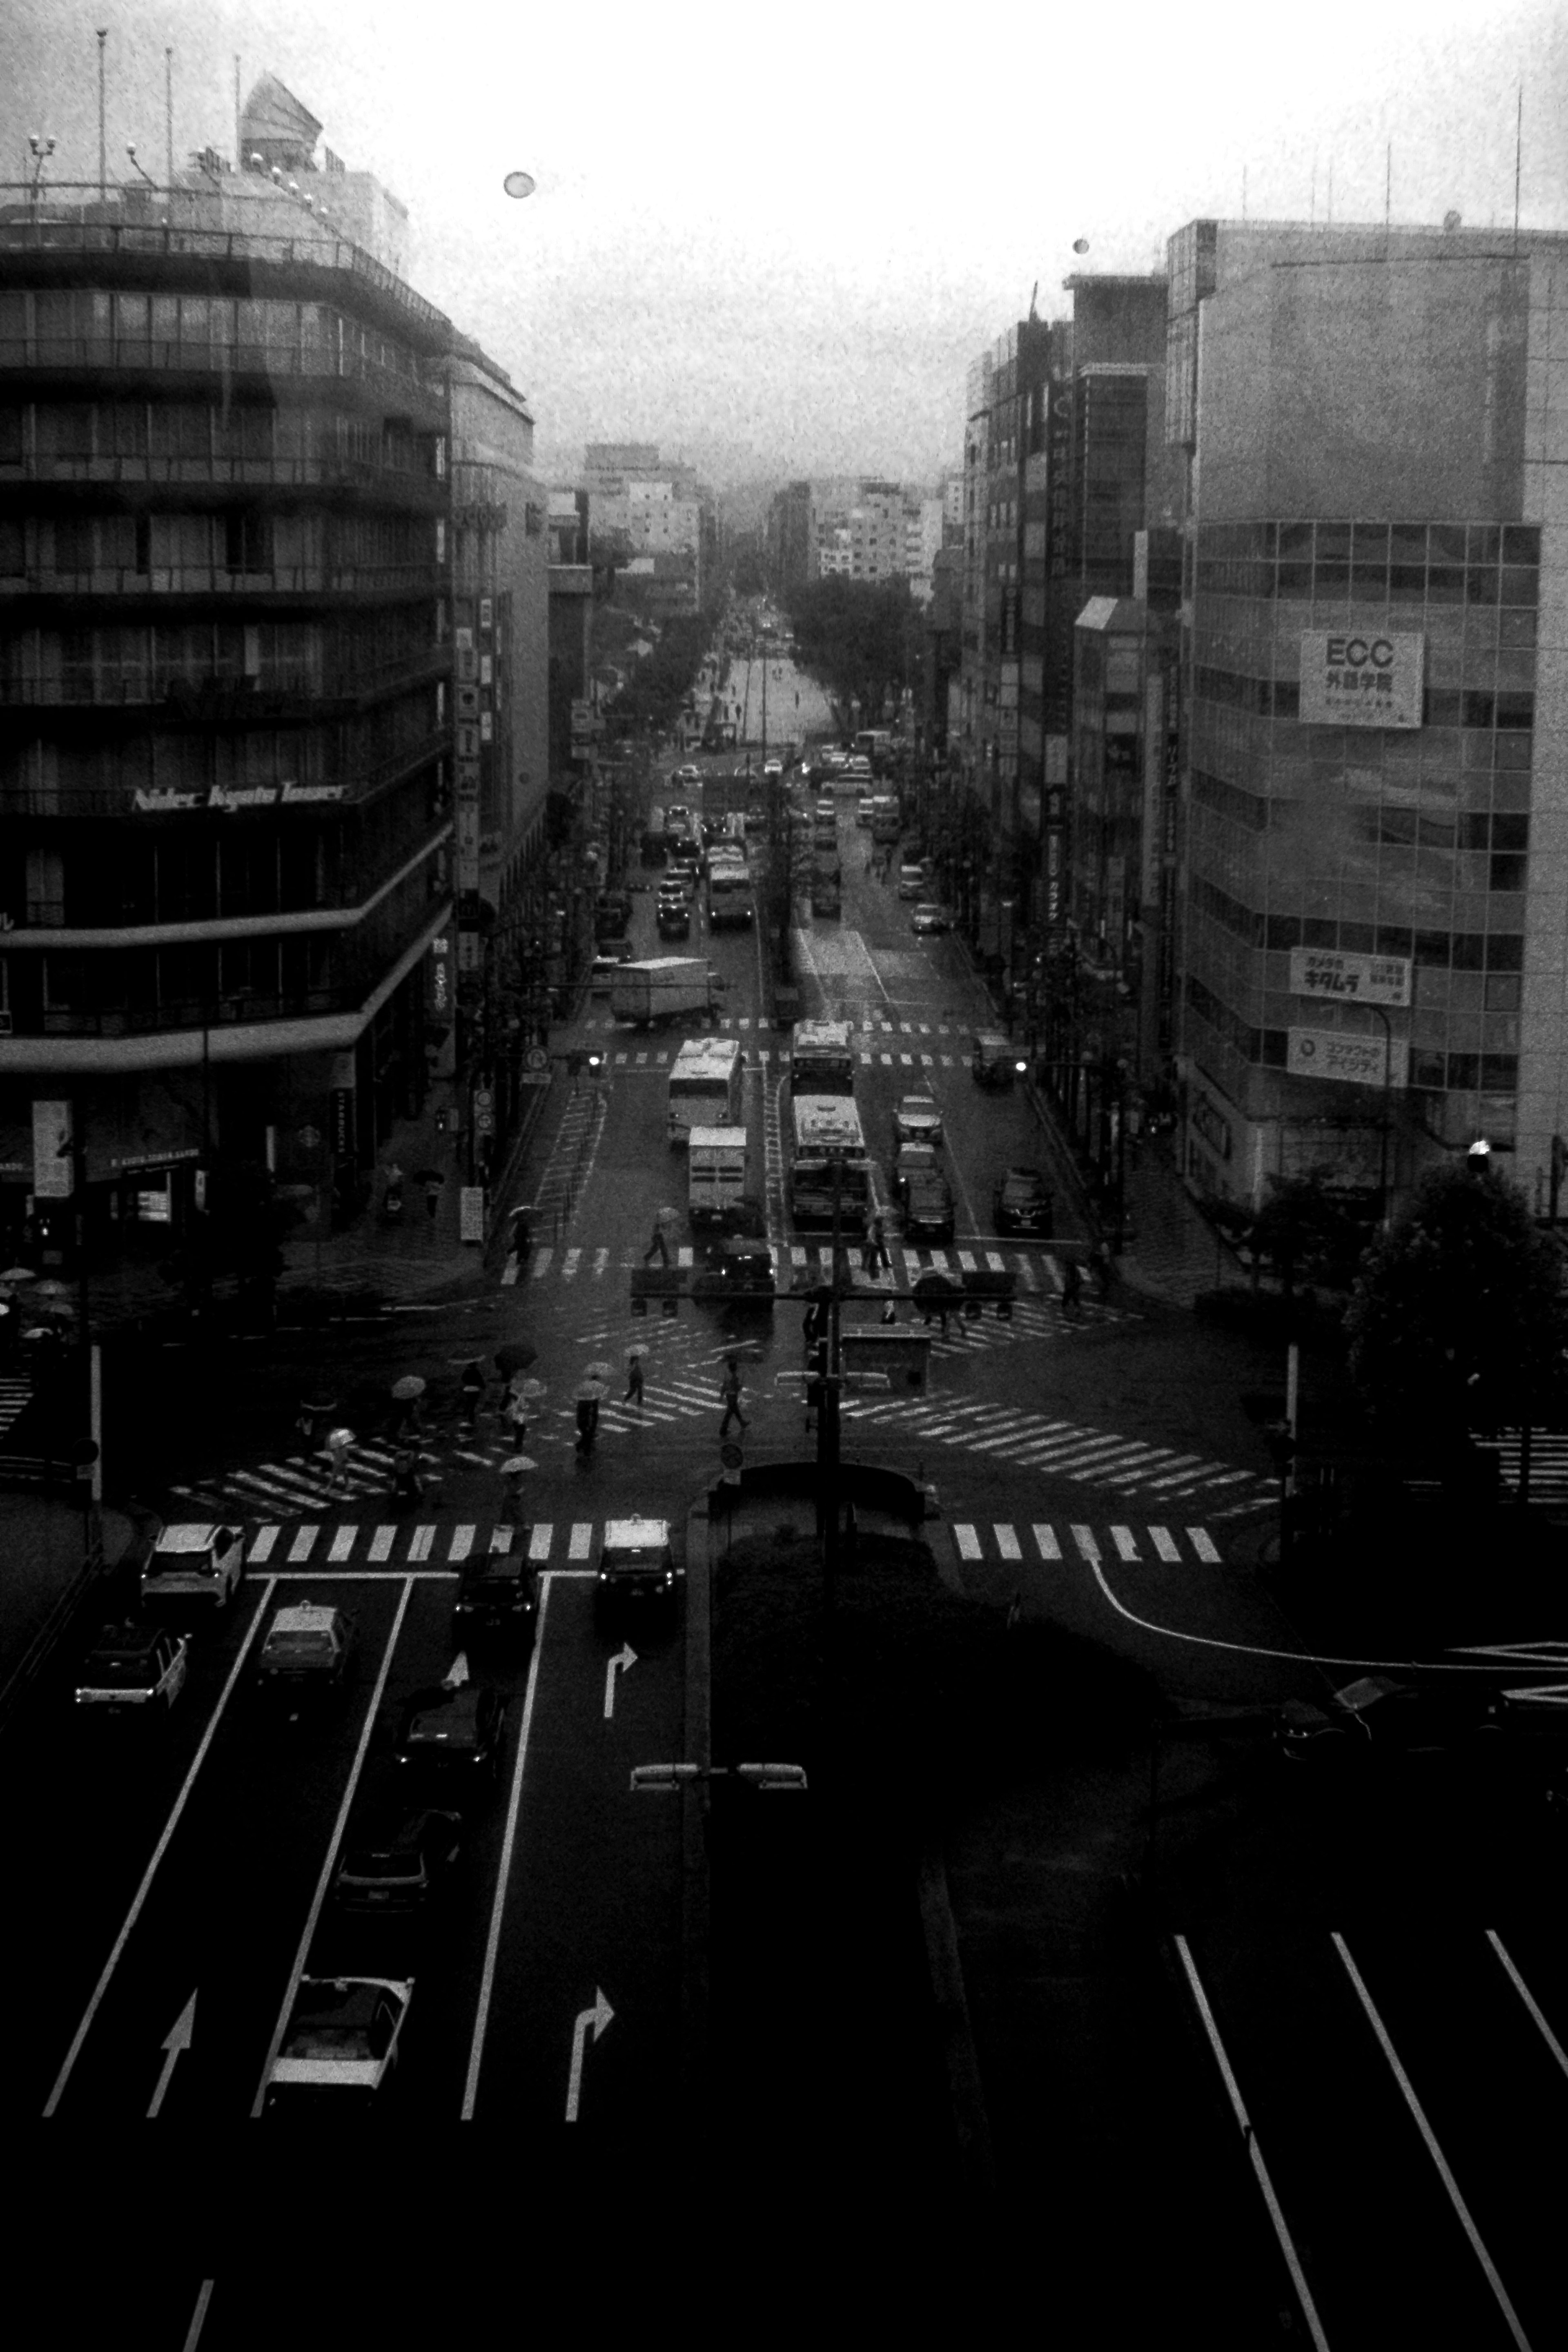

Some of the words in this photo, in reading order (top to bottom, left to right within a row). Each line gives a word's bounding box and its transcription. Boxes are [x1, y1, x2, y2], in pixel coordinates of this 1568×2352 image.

[1327, 639, 1393, 668] ECC
[1326, 670, 1392, 693] 外語学院
[208, 784, 277, 813] Kyoto
[282, 781, 350, 802] Tower
[1305, 970, 1360, 993] キタムラ
[337, 1091, 346, 1154] STARBUCKS
